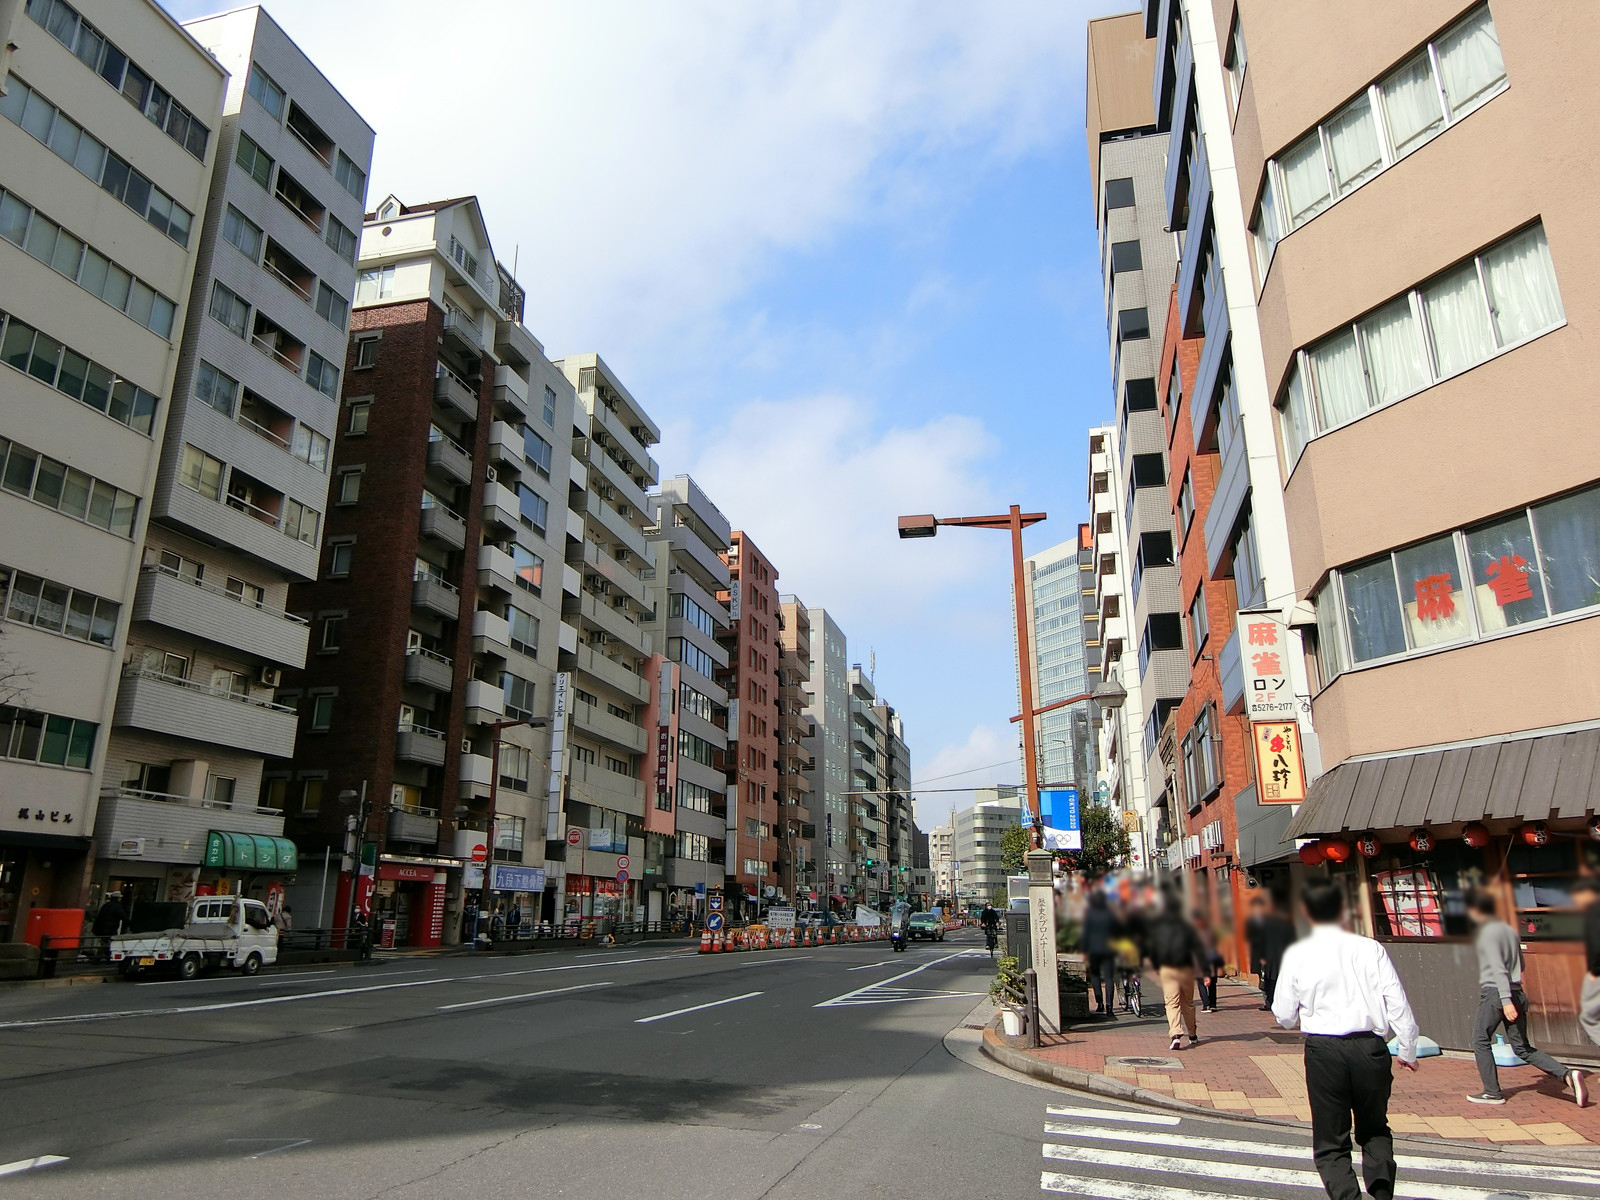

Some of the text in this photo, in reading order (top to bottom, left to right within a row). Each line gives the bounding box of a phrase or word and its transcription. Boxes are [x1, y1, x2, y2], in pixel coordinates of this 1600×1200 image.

[1414, 554, 1533, 622] 麻雀
[1248, 622, 1282, 676] 麻雀
[556, 673, 566, 717] クリエイトビル
[1253, 678, 1286, 691] ロン
[1255, 692, 1276, 703] 2F
[398, 868, 417, 877] ACCEA
